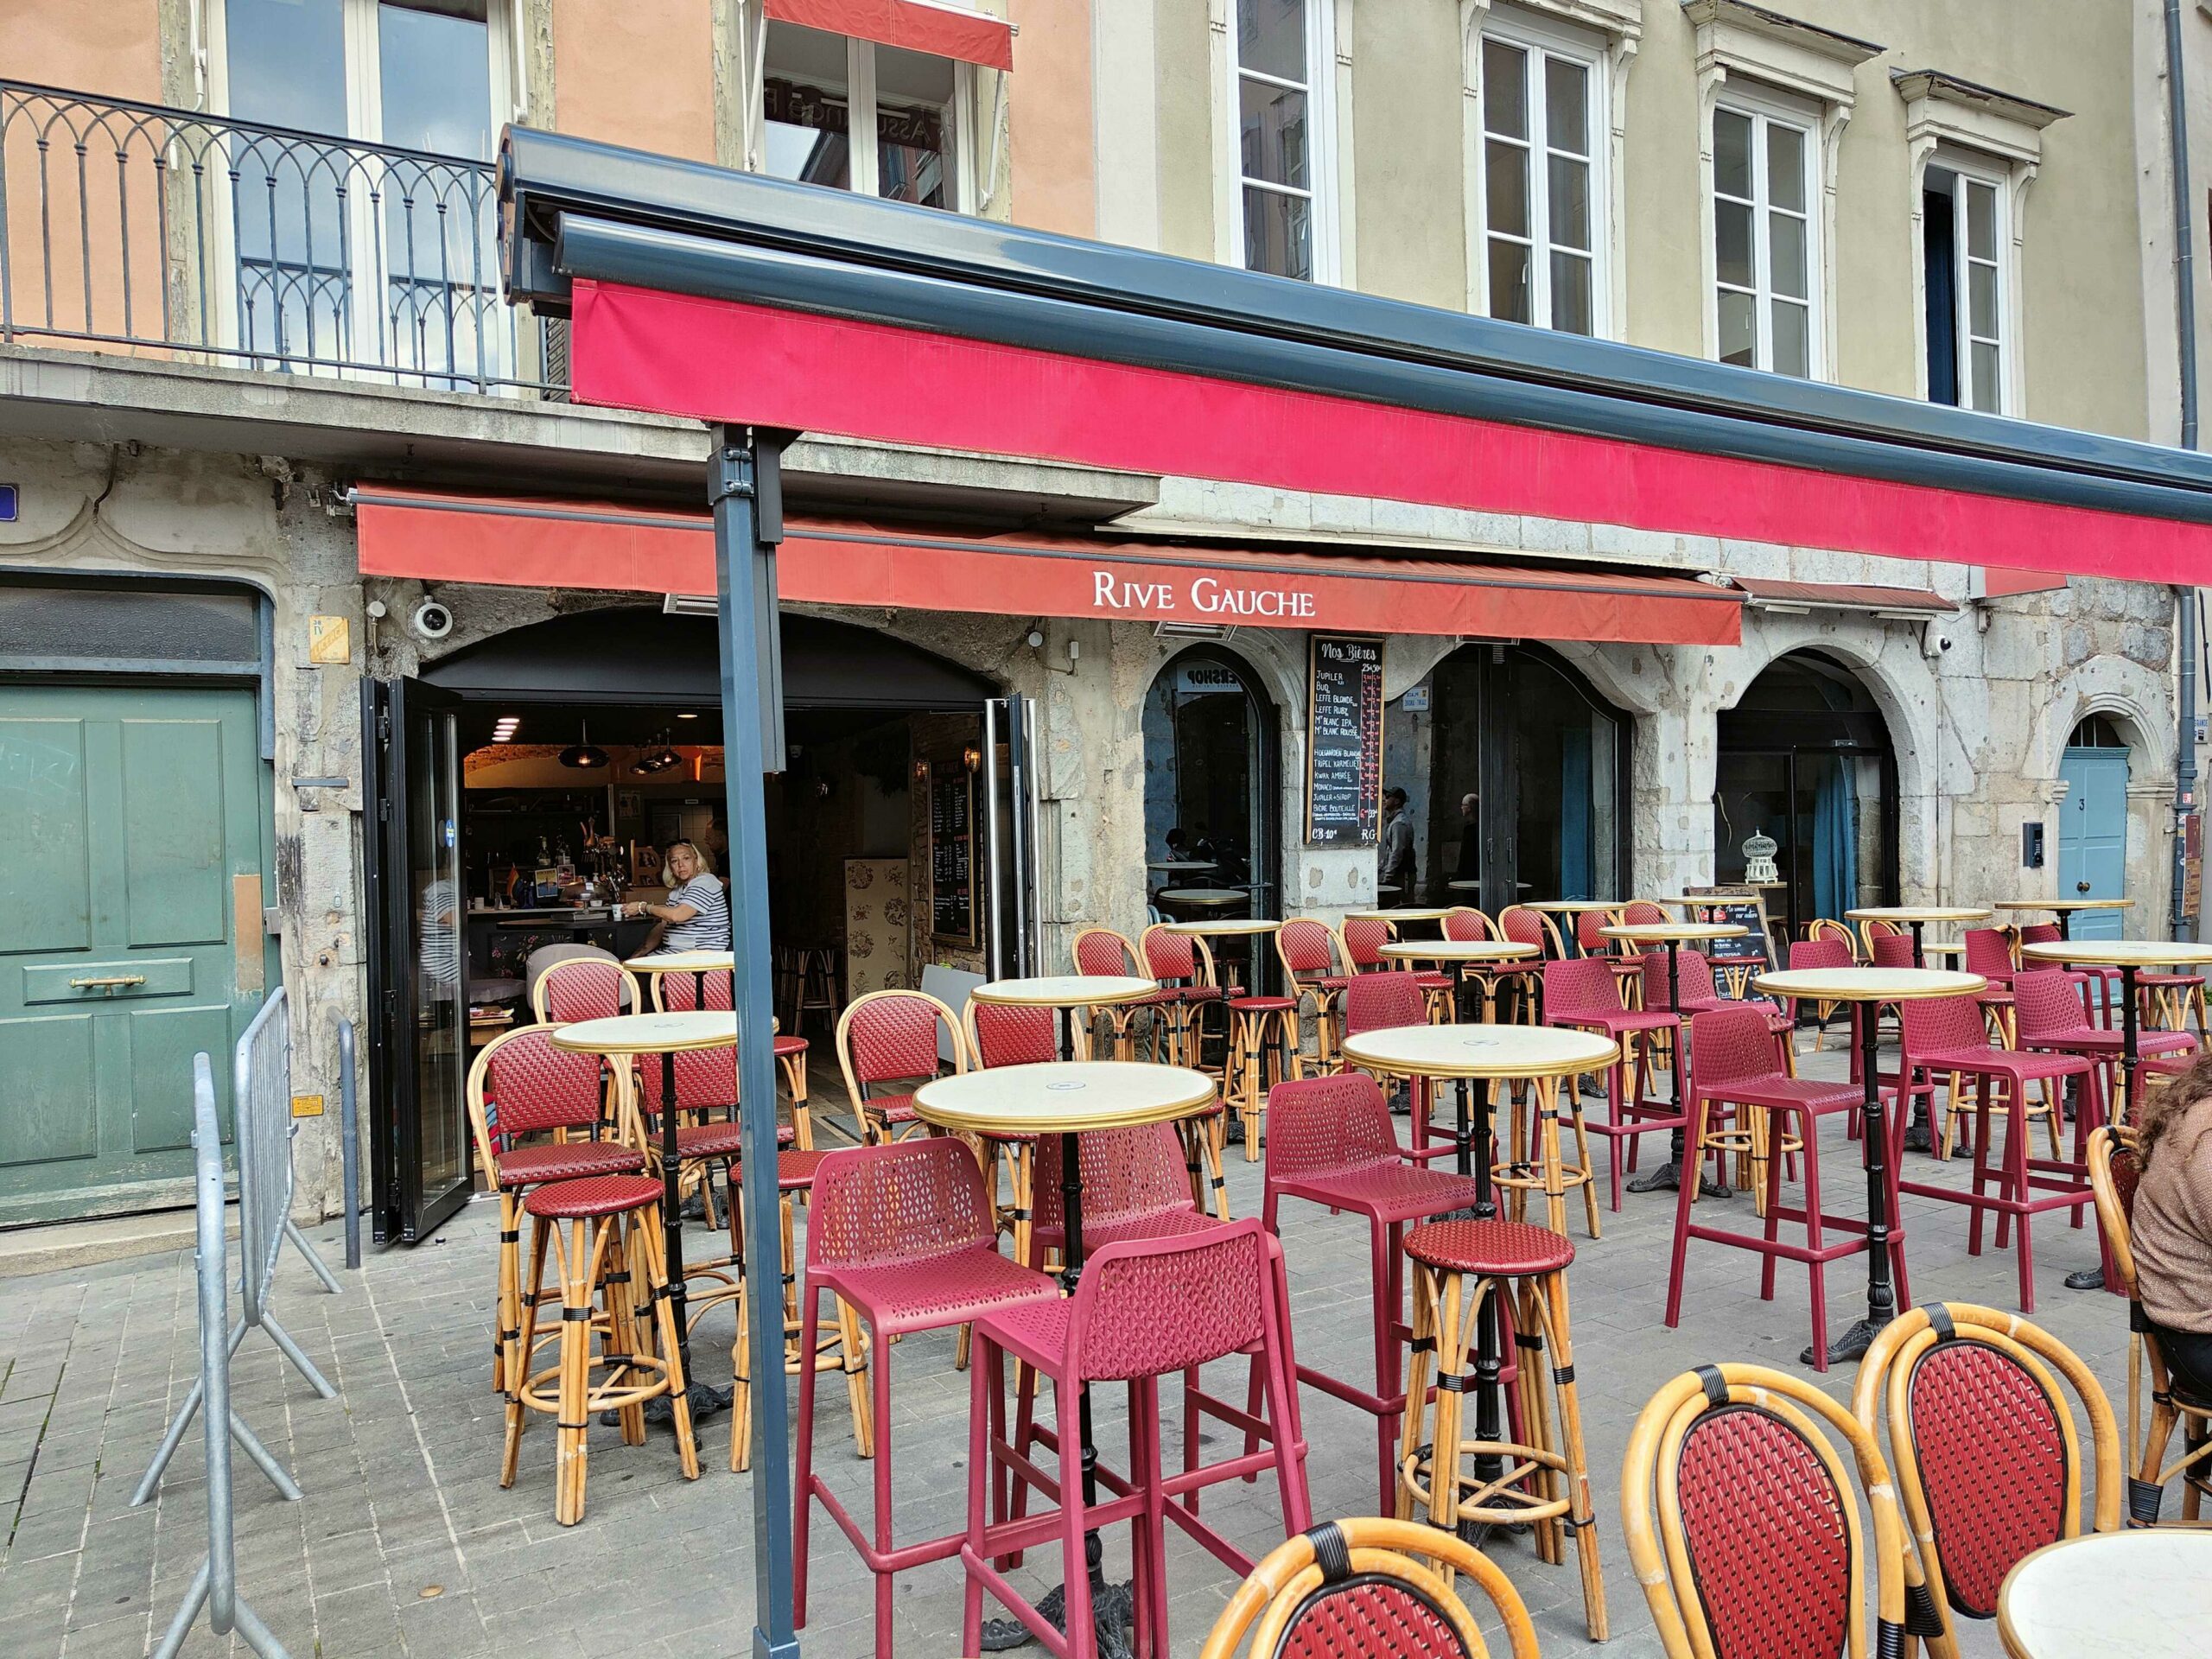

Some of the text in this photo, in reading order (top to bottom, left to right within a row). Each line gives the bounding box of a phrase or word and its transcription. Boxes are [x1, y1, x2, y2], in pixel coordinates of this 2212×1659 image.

[1093, 571, 1316, 617] RIVE GAUCHE
[1321, 643, 1376, 661] Nos Bières
[2079, 798, 2085, 810] 3
